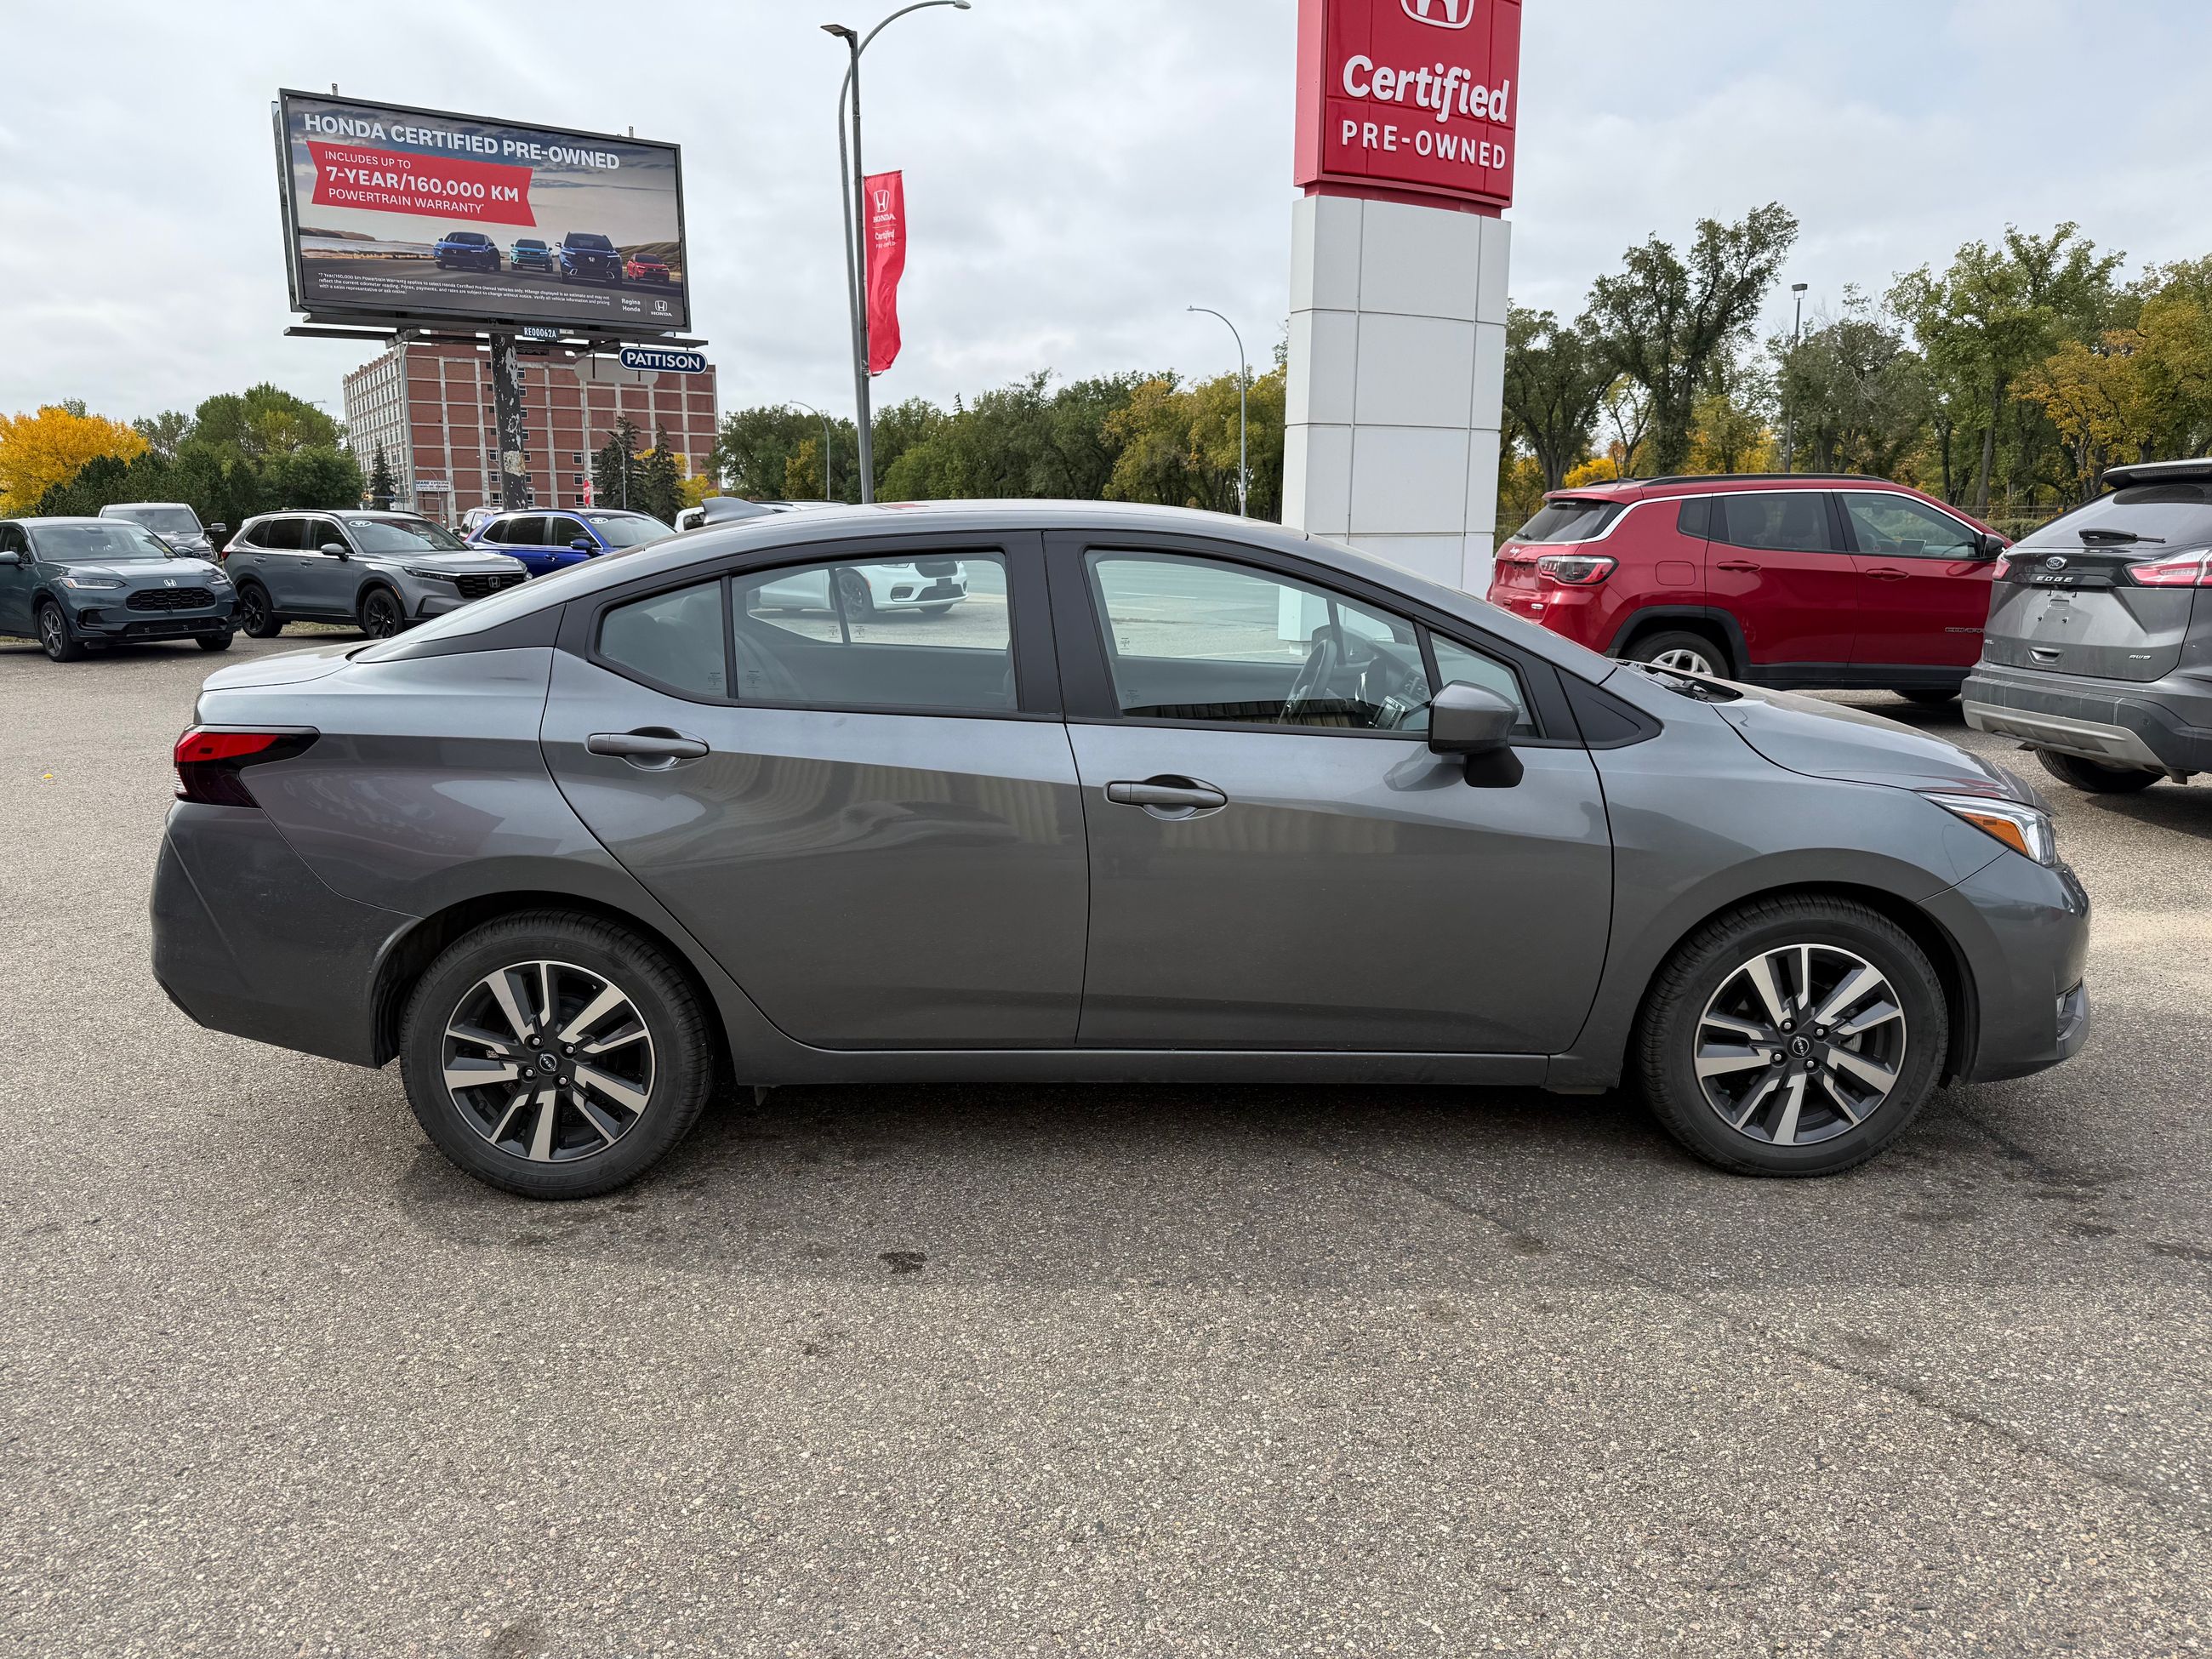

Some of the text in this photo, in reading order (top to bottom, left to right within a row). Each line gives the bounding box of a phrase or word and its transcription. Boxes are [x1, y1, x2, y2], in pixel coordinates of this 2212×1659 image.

[1343, 54, 1509, 123] Certified
[304, 113, 620, 170] HONDA CERTIFIED PRE-OWNED
[1342, 120, 1506, 170] PRE-OWNED
[325, 151, 411, 169] INCLUDES UP TO
[326, 165, 519, 202] 7-YEAR/160,000 KM
[328, 187, 411, 207] POWERTRAIN
[873, 214, 896, 223] HONDA
[523, 327, 557, 339] RE00062A
[626, 351, 700, 370] PATTISON
